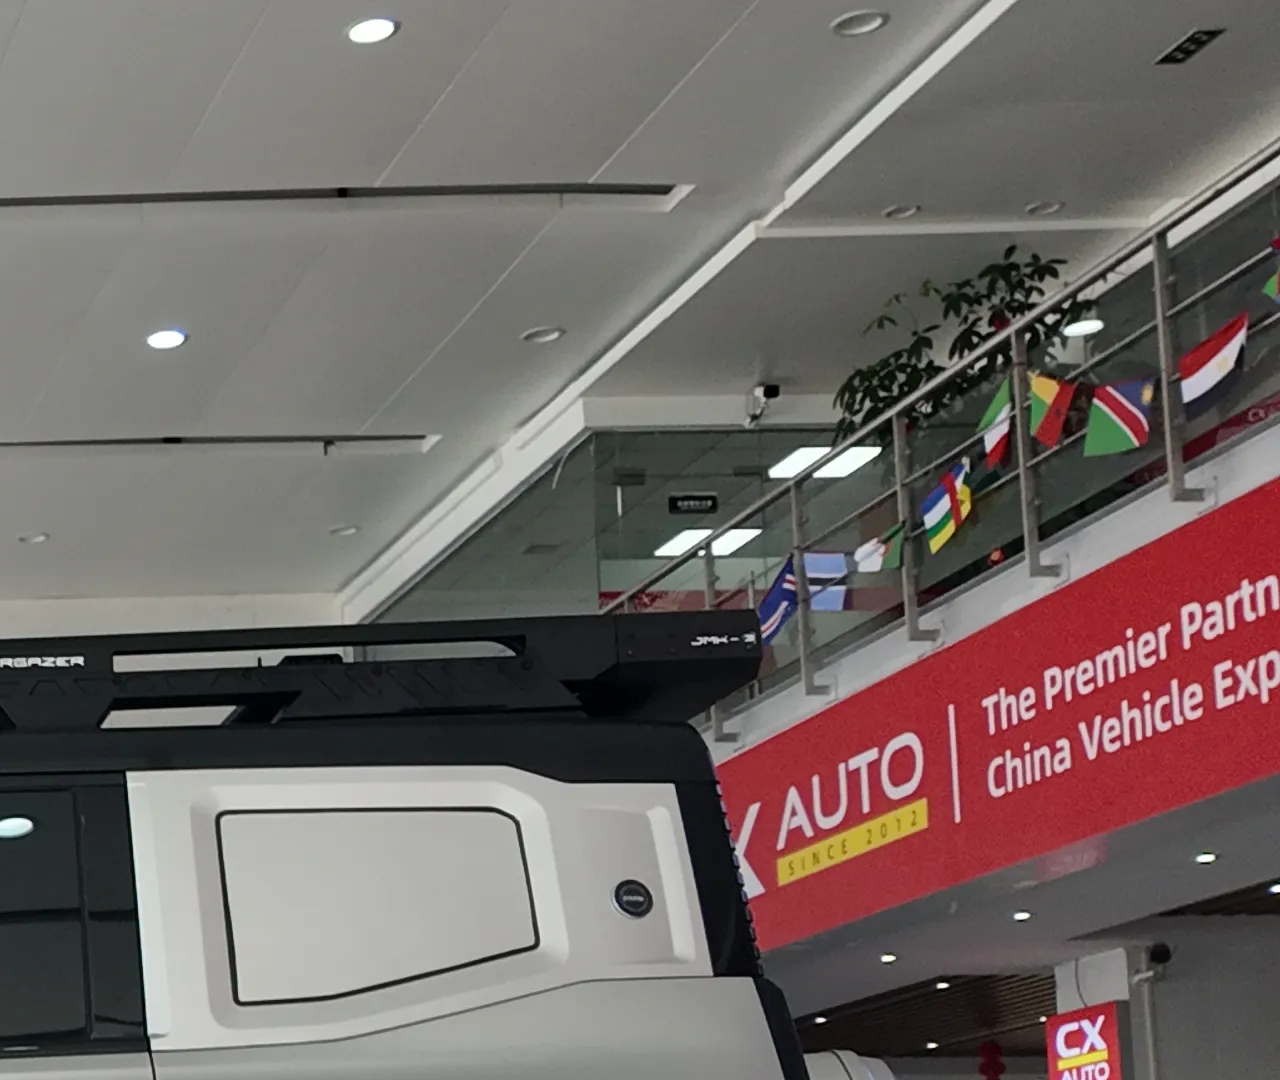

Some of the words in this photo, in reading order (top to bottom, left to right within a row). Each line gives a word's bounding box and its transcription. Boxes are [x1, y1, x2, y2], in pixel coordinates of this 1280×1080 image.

[981, 686, 1037, 736] The
[1043, 622, 1171, 711] Premier
[1180, 574, 1280, 650] Partn
[987, 741, 1072, 798] China
[1078, 678, 1204, 761] Vehicle
[1213, 649, 1280, 710] Exp
[776, 732, 924, 851] AUTO
[788, 838, 849, 877] SINCE
[866, 809, 918, 845] 2012
[1056, 1015, 1108, 1058] CX
